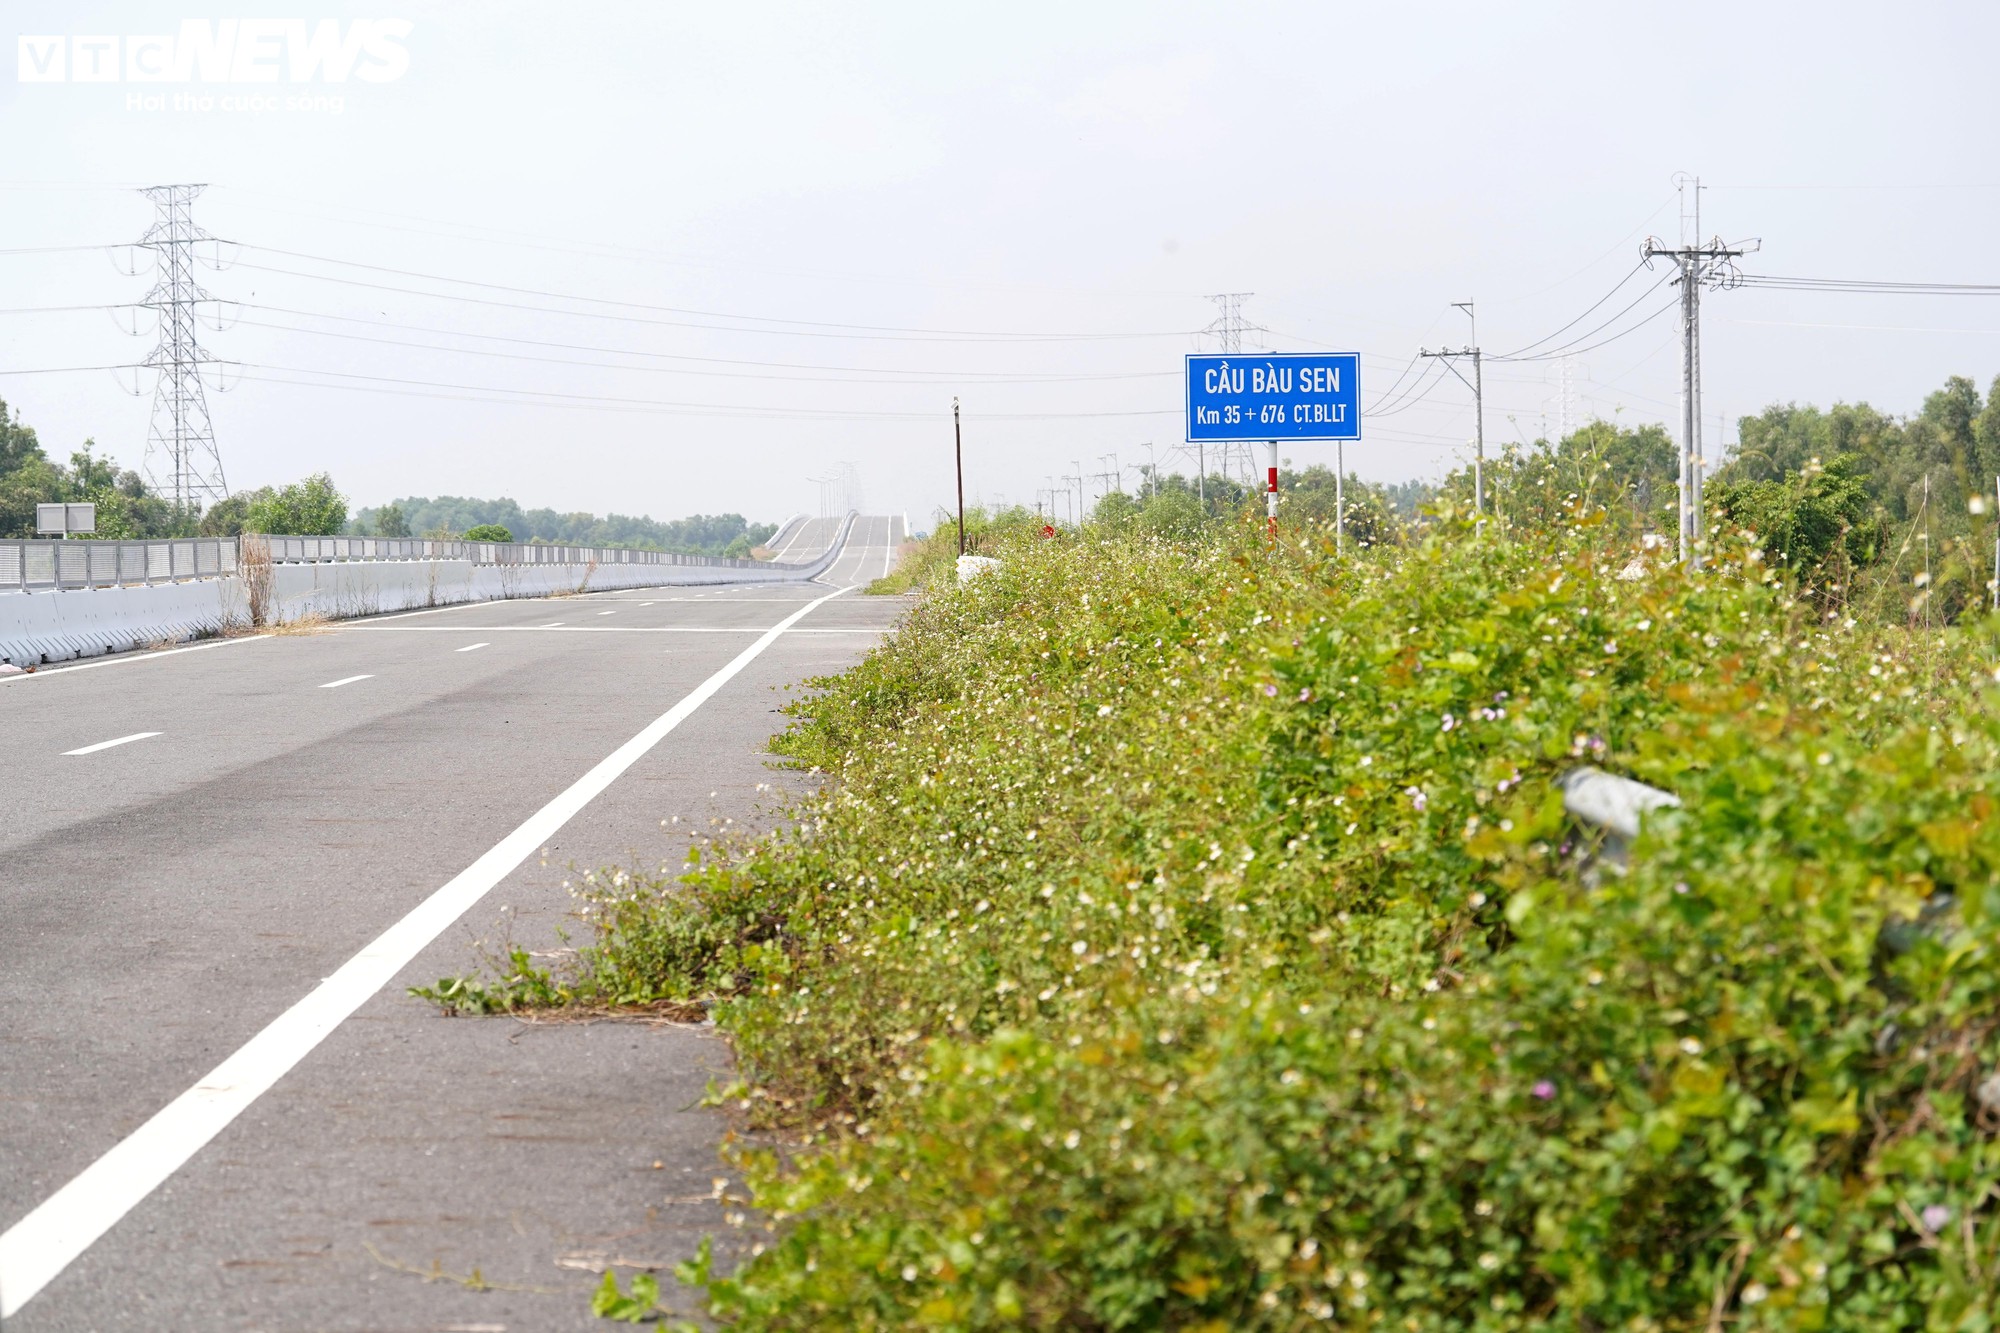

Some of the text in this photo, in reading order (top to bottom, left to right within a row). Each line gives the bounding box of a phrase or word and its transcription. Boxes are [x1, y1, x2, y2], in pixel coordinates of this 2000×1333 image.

[1205, 361, 1340, 394] CẦU BÀU SEN
[1197, 403, 1347, 424] Km 35 + 676 CT.BLLT
